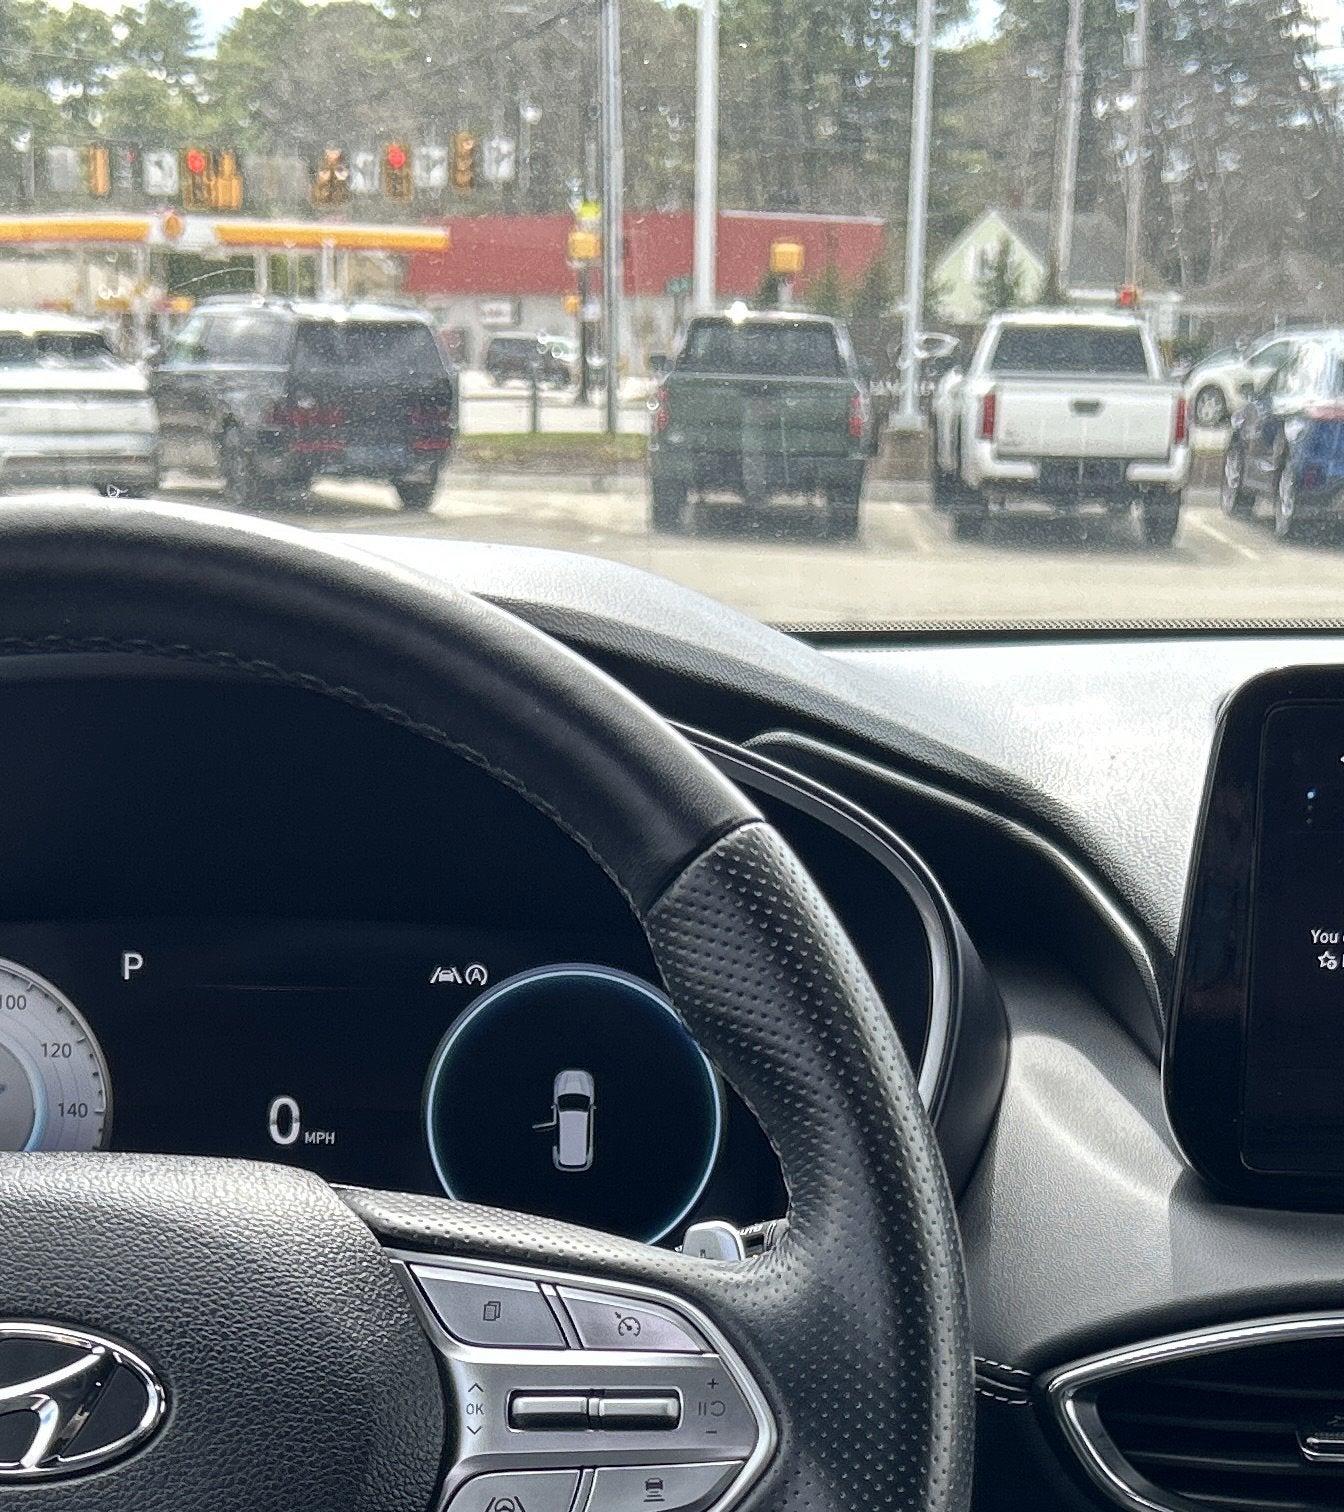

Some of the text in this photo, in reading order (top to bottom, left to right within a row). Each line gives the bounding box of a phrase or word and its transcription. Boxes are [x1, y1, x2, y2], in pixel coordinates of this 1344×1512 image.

[1311, 930, 1338, 944] You
[124, 953, 143, 980] P
[42, 1043, 72, 1060] 120
[58, 1102, 88, 1119] 140
[269, 1097, 335, 1145] 0 MPH
[465, 1401, 485, 1416] OK
